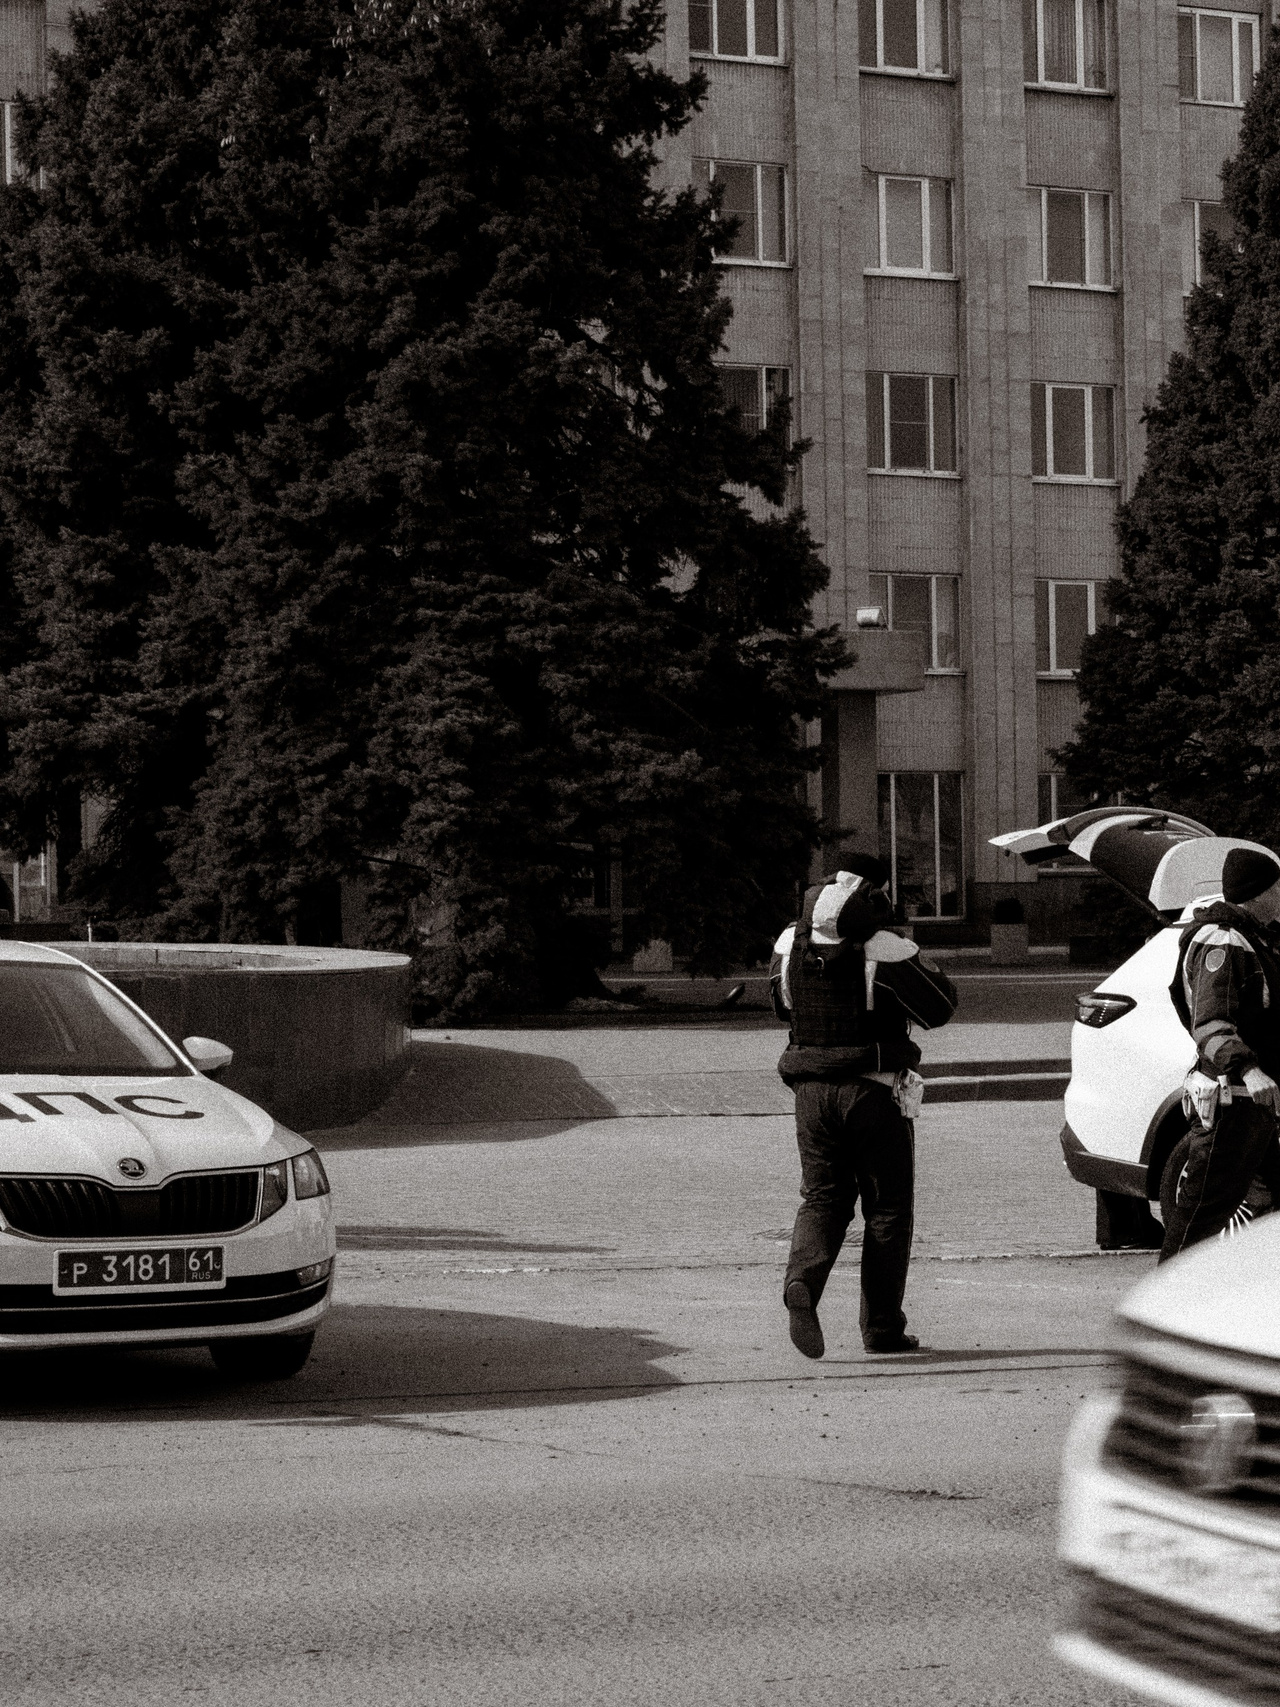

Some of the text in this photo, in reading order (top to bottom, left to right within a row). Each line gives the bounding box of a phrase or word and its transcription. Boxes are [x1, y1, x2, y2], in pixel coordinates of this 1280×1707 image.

[72, 1249, 215, 1284] Р 3181 61
[191, 1271, 211, 1281] RUS
